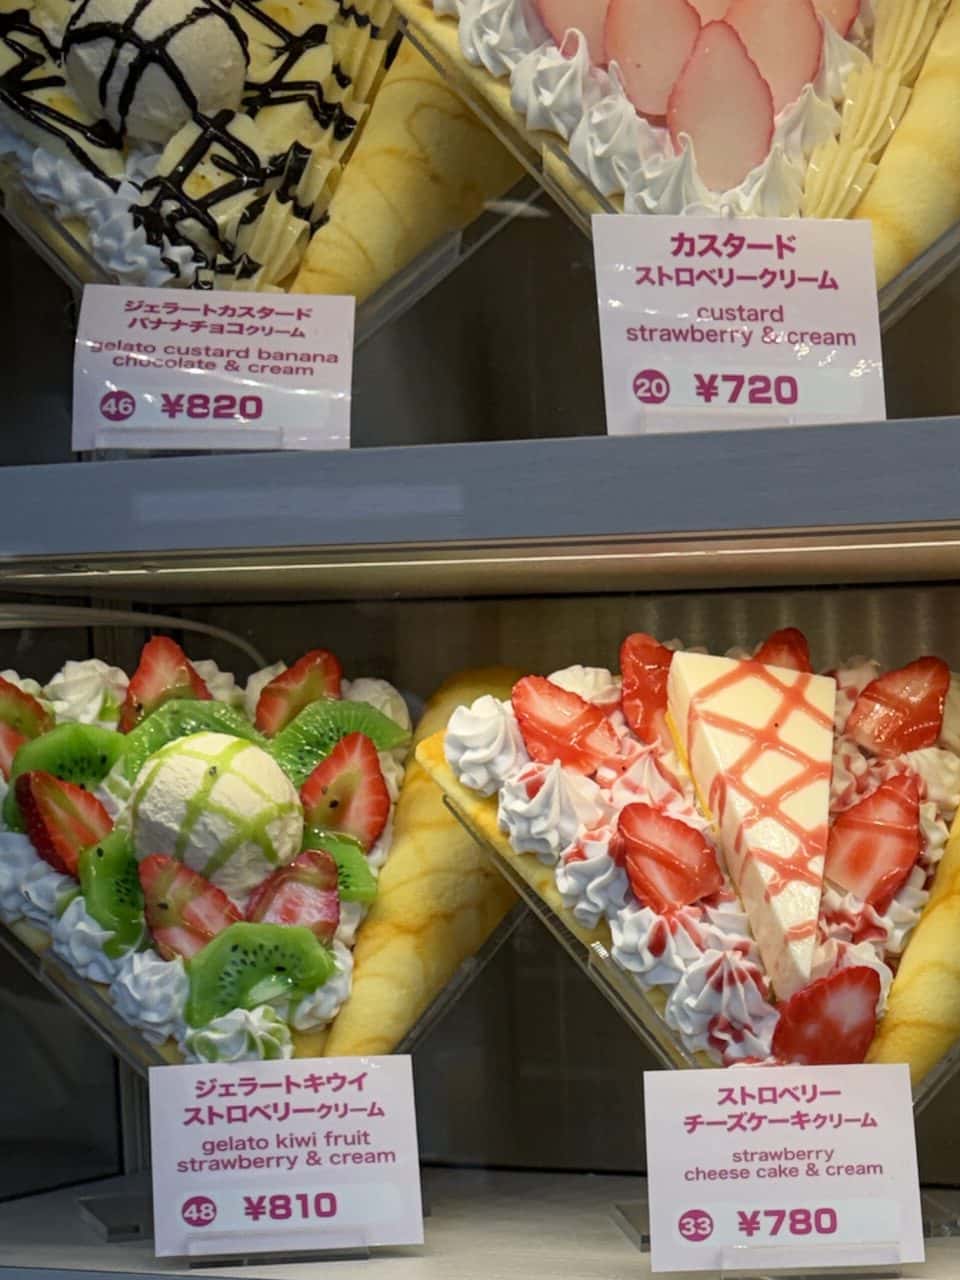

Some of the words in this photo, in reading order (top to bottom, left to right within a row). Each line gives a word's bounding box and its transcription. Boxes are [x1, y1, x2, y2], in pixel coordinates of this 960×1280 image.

[670, 233, 796, 259] カスタード
[635, 266, 838, 290] ストロベリークリーム
[124, 300, 313, 320] ジェラートカスタード
[697, 305, 784, 322] custard
[129, 317, 306, 338] バナナチョコクリーム
[626, 325, 752, 347] strawberry
[761, 327, 776, 344] &
[786, 330, 856, 346] cream
[164, 343, 249, 359] custard
[258, 350, 339, 364] banana
[112, 354, 216, 370] chocolate
[224, 357, 240, 371] &
[248, 362, 314, 376] cream
[636, 380, 667, 397] 20
[694, 373, 798, 404] ¥720
[102, 398, 133, 415] 46
[161, 394, 263, 419] ¥820
[195, 1073, 367, 1098] ジェラートキウイ
[717, 1084, 841, 1105] ストロベリー
[183, 1102, 385, 1126] ストロベリークリーム
[684, 1111, 877, 1134] チーズケーキクリーム
[202, 1136, 269, 1156] gelato
[276, 1133, 317, 1148] kiwi
[324, 1131, 371, 1146] fruit
[177, 1154, 298, 1172] strawberry
[306, 1151, 322, 1166] &
[329, 1151, 396, 1164] cream
[732, 1147, 834, 1163] strawberry
[684, 1166, 750, 1181] cheese
[756, 1164, 799, 1178] cake
[806, 1163, 819, 1176] &
[826, 1162, 883, 1176] cream
[183, 1202, 215, 1220] 48
[244, 1192, 337, 1221] ¥810
[680, 1217, 711, 1234] 33
[737, 1208, 837, 1236] ¥780
